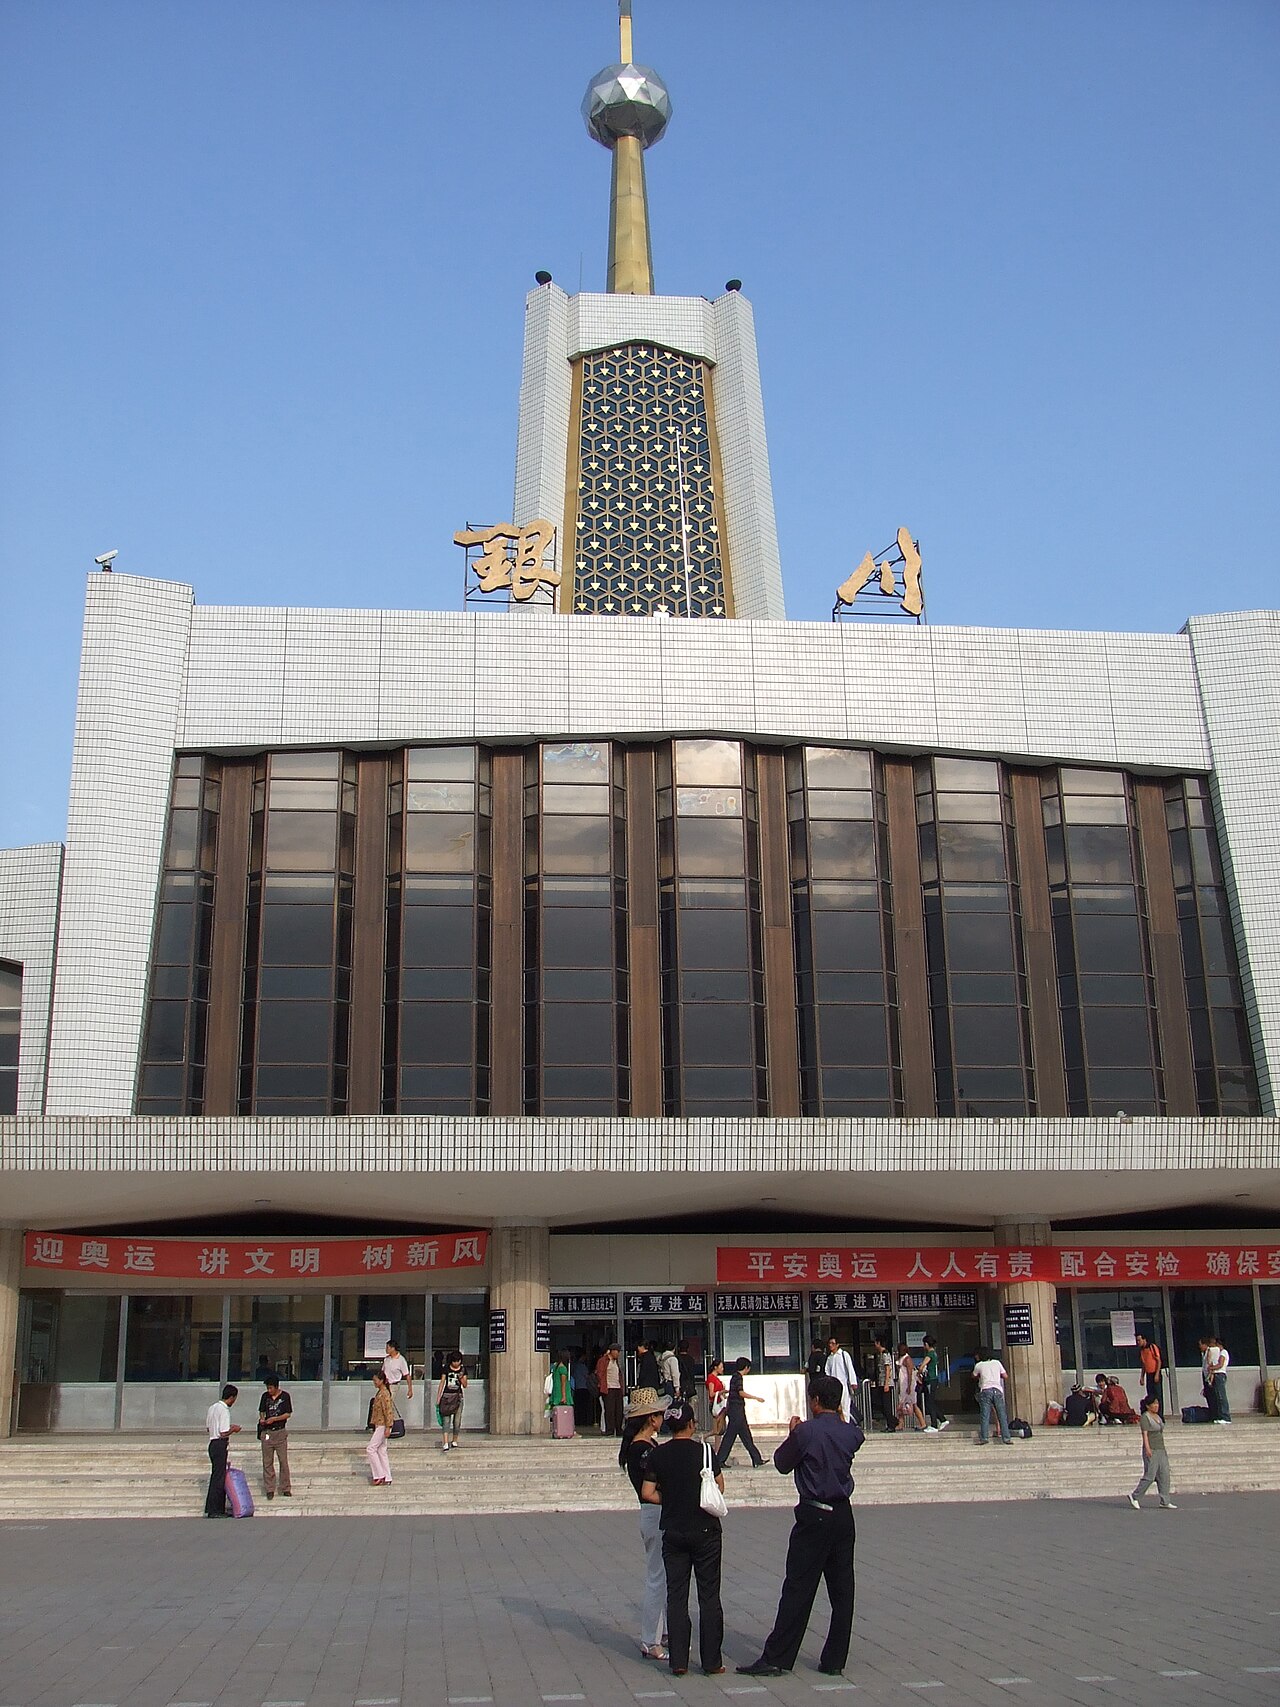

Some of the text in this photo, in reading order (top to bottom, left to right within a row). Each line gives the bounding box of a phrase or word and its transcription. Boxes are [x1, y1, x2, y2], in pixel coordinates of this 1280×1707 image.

[32, 1237, 482, 1275] 迎奥运 讲文明 树新风
[747, 1252, 878, 1279] 平安奥运
[906, 1251, 1034, 1278] 人人有责
[1060, 1250, 1180, 1277] 配合安检
[628, 1296, 703, 1312] 凭票进站
[717, 1295, 800, 1310] 无票人员请勿进入候车室
[814, 1294, 887, 1310] 凭票进站
